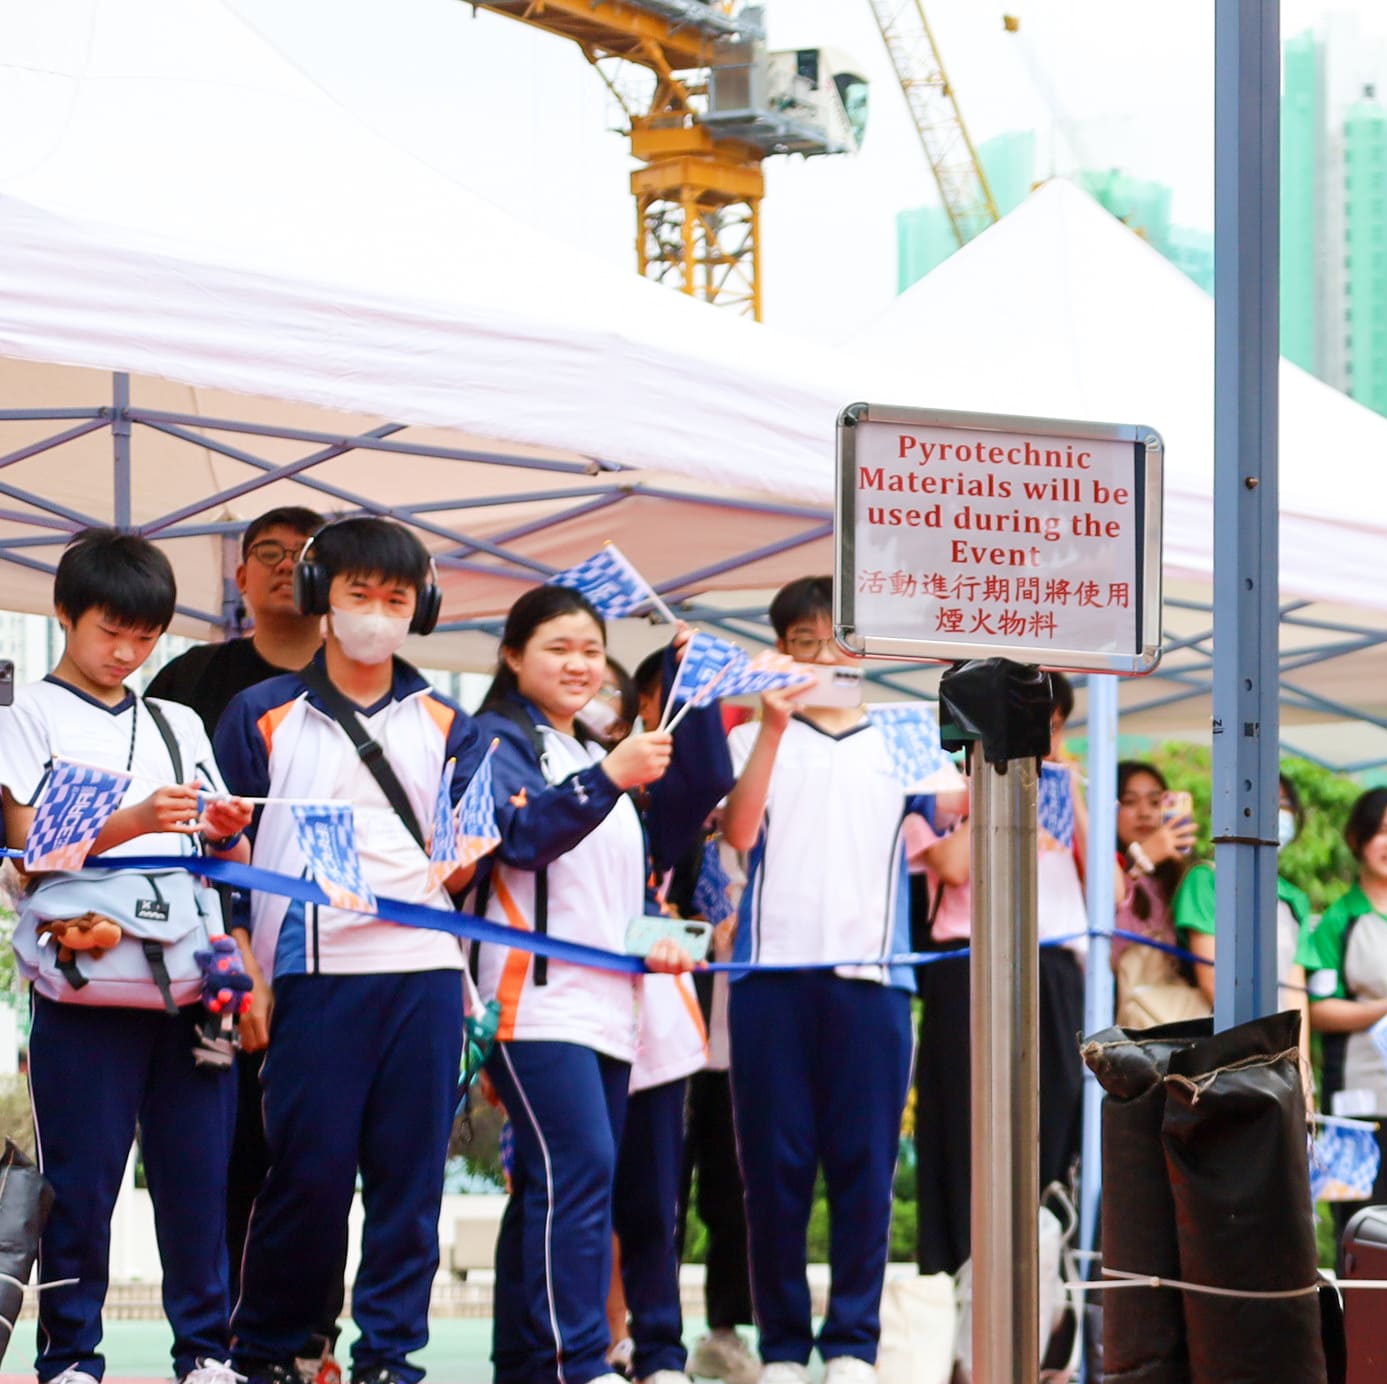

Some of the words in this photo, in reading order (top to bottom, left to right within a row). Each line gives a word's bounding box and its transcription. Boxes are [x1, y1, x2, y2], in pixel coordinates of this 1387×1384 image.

[898, 435, 1092, 470] Pyrotechnic
[859, 466, 1012, 499] Materials
[1024, 478, 1081, 503] will
[1093, 480, 1129, 505] be
[868, 504, 942, 528] used
[954, 506, 1061, 541] during
[1072, 513, 1120, 538] the
[951, 539, 1040, 567] Event
[858, 570, 1130, 608] 活動進行期間將使用
[935, 607, 1058, 639] 煙火物料
